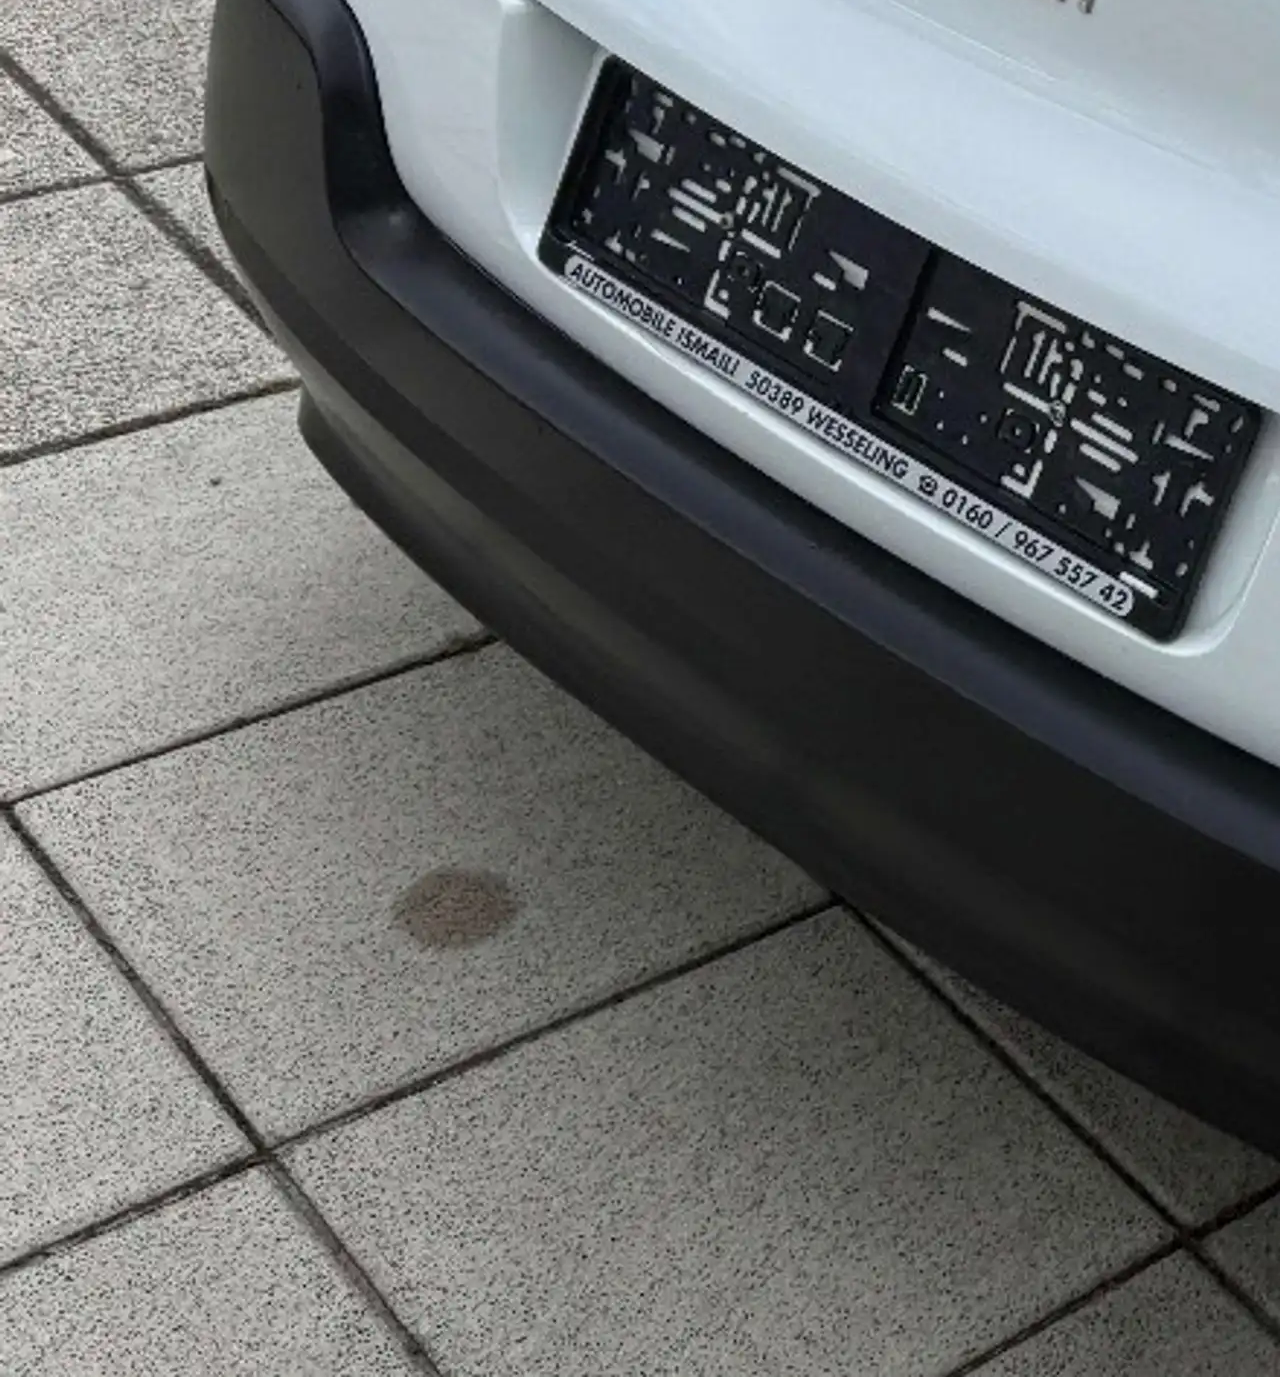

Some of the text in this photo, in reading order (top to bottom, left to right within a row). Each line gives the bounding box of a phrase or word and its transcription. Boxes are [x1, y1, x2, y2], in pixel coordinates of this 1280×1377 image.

[570, 262, 675, 338] AUTOMOBILE
[744, 371, 804, 415] 50389
[806, 405, 909, 479] WESSELING
[942, 489, 993, 529] 0160
[1014, 530, 1052, 562] 967
[1053, 556, 1098, 588] 557
[1099, 582, 1129, 611] 42
